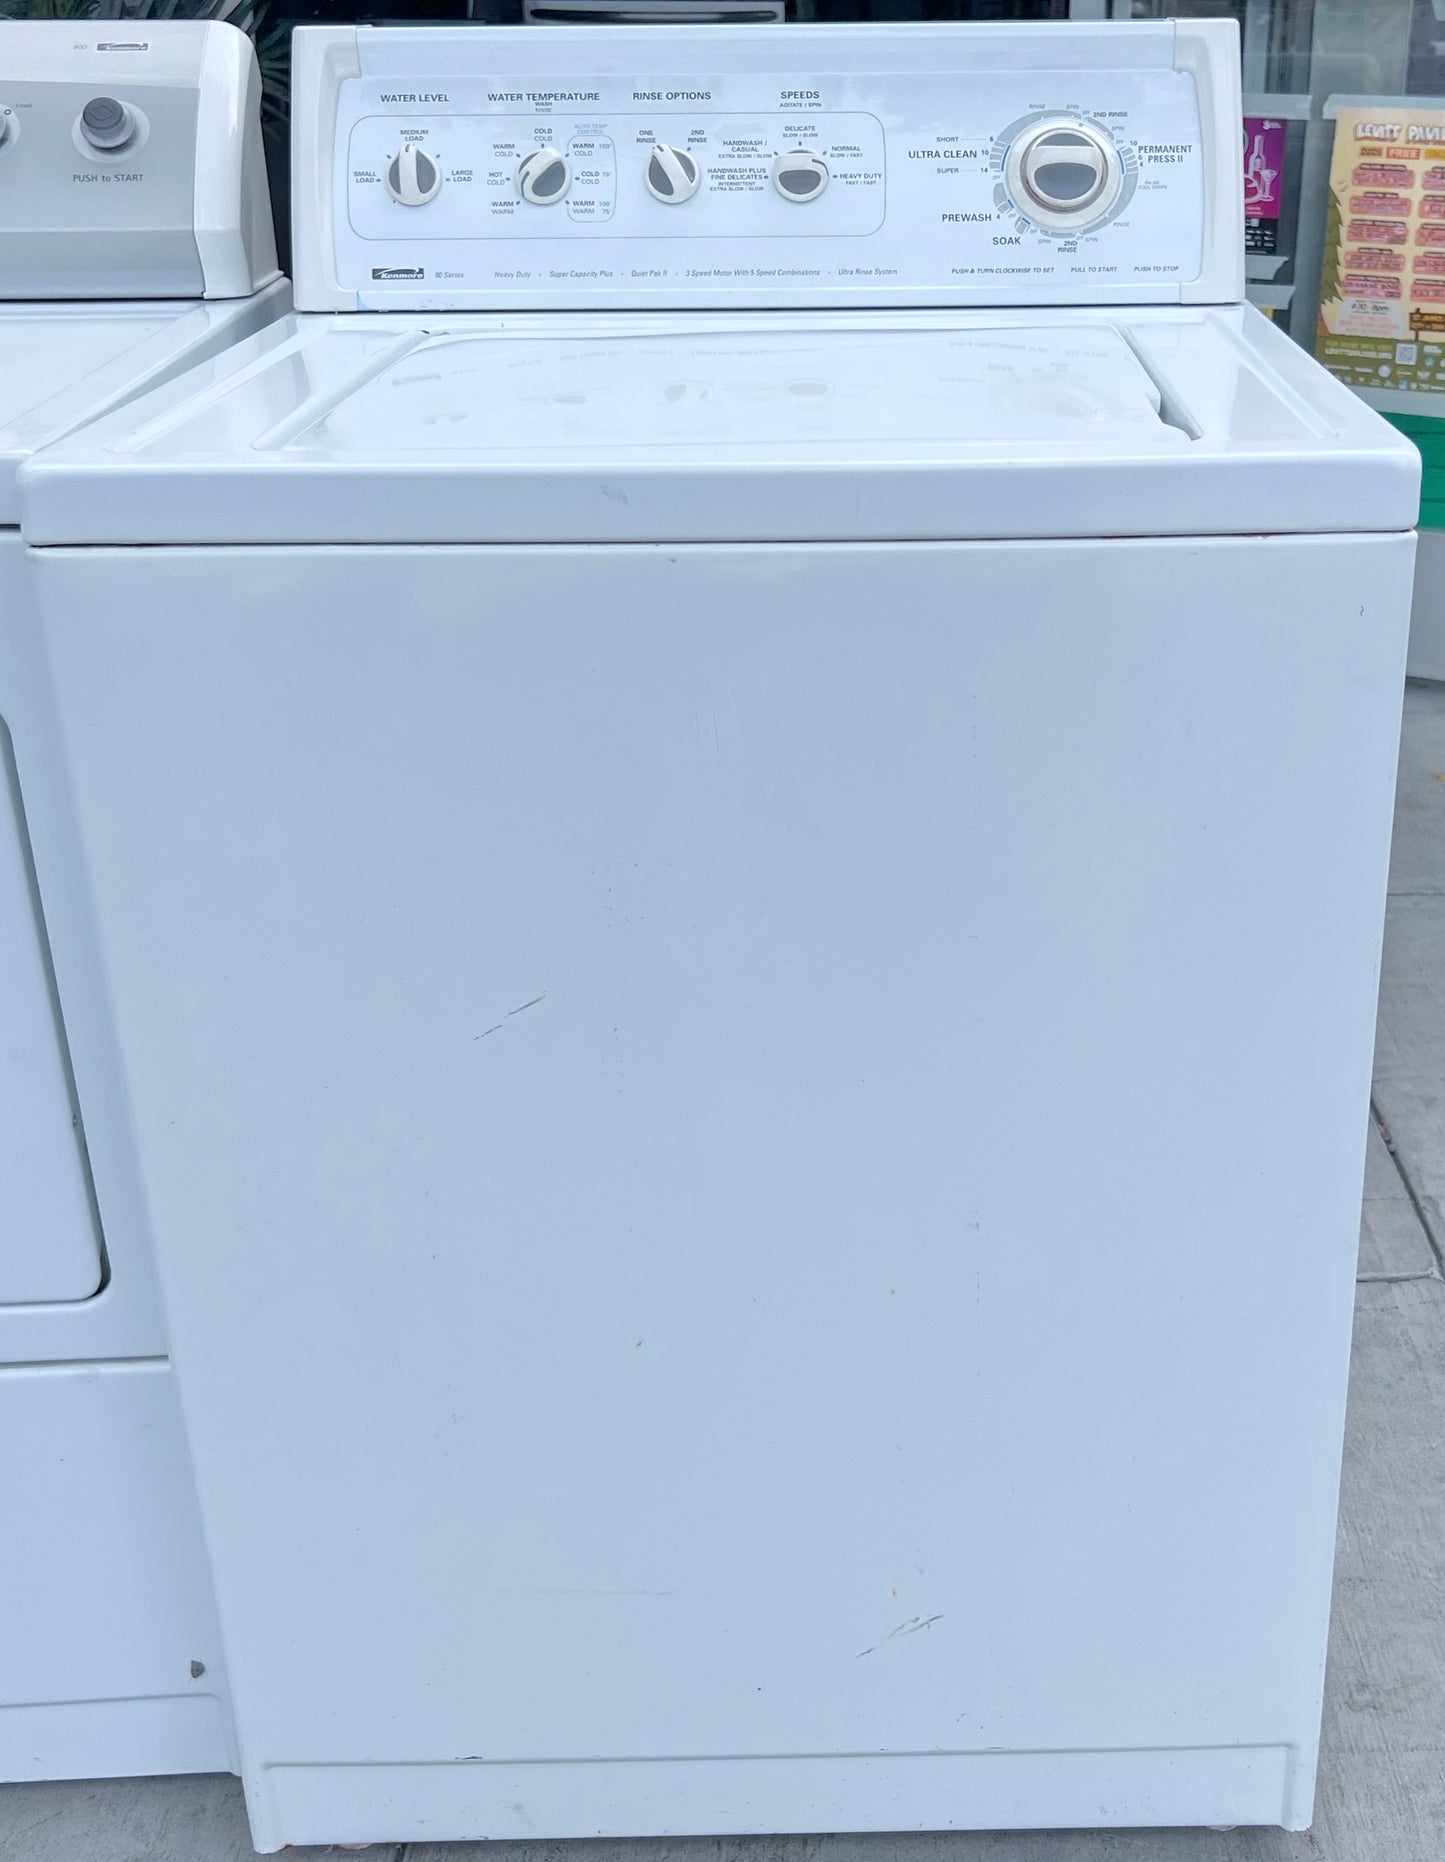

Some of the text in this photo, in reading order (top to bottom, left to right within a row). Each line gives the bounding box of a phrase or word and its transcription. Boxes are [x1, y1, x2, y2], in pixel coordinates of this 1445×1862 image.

[381, 94, 450, 102] WATER LEVEL
[488, 92, 600, 101] WATER TEMPERATURE
[632, 92, 712, 100] RINSE OPTIONS
[780, 91, 820, 100] SPEEDS
[1138, 145, 1192, 154] PERMANENT
[908, 150, 941, 159] ULTRA
[943, 150, 978, 158] CLEAN
[1148, 155, 1183, 163] PRESS II
[73, 174, 98, 182] PUSH
[114, 173, 143, 182] START
[942, 214, 992, 222] PREWASH
[992, 236, 1021, 245] SOAK
[494, 271, 531, 279] Heavy Duty
[549, 270, 569, 278] Super
[570, 270, 598, 279] Capacity
[631, 270, 648, 278] Quiet
[691, 269, 712, 278] Speed
[713, 269, 732, 277] Motor
[755, 269, 776, 278] Speed
[838, 268, 898, 277] Ultra Rinse System
